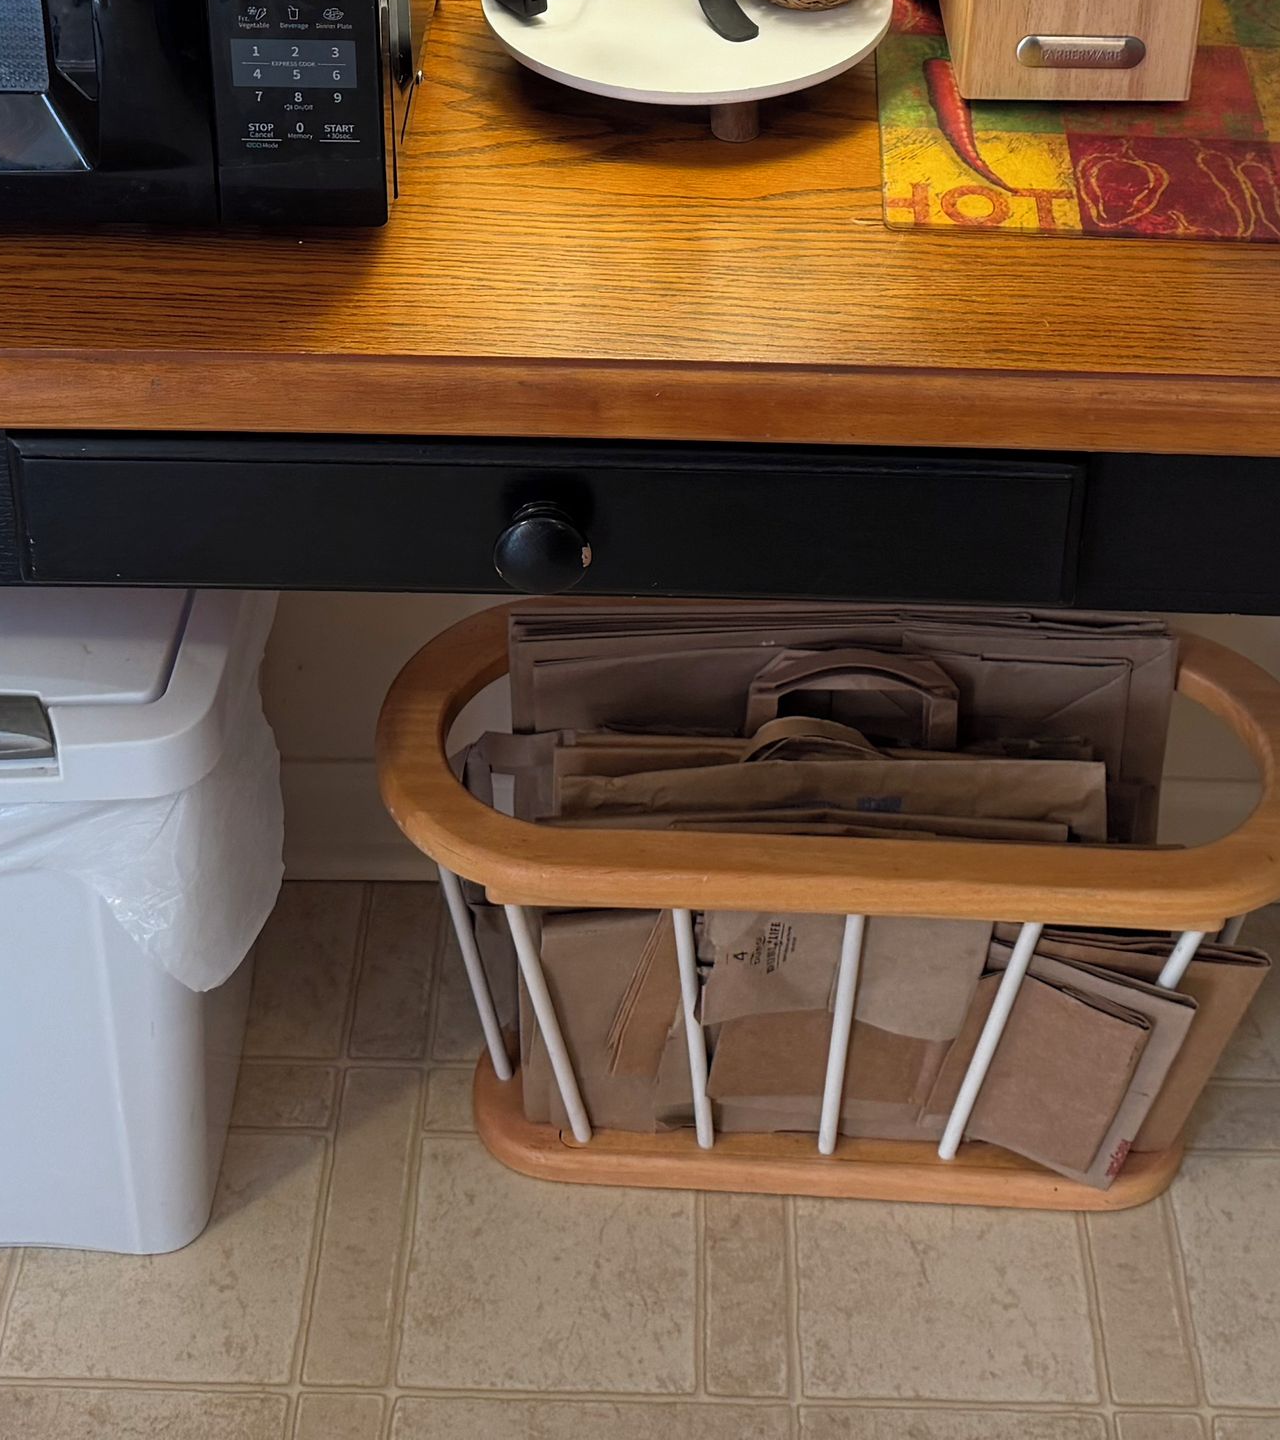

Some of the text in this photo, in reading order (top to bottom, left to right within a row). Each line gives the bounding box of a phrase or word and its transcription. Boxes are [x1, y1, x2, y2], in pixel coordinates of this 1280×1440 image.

[252, 46, 260, 57] 1
[291, 46, 299, 57] 2
[331, 47, 340, 58] 3
[1040, 47, 1122, 61] FARBERWARE
[253, 68, 261, 80] 4
[292, 69, 301, 80] 5
[332, 70, 340, 81] 6
[255, 91, 263, 102] 7
[294, 91, 303, 102] 8
[333, 92, 342, 103] 9
[248, 123, 274, 132] STOP
[295, 122, 304, 133] 0
[324, 124, 355, 133] START
[886, 182, 1076, 232] HOT
